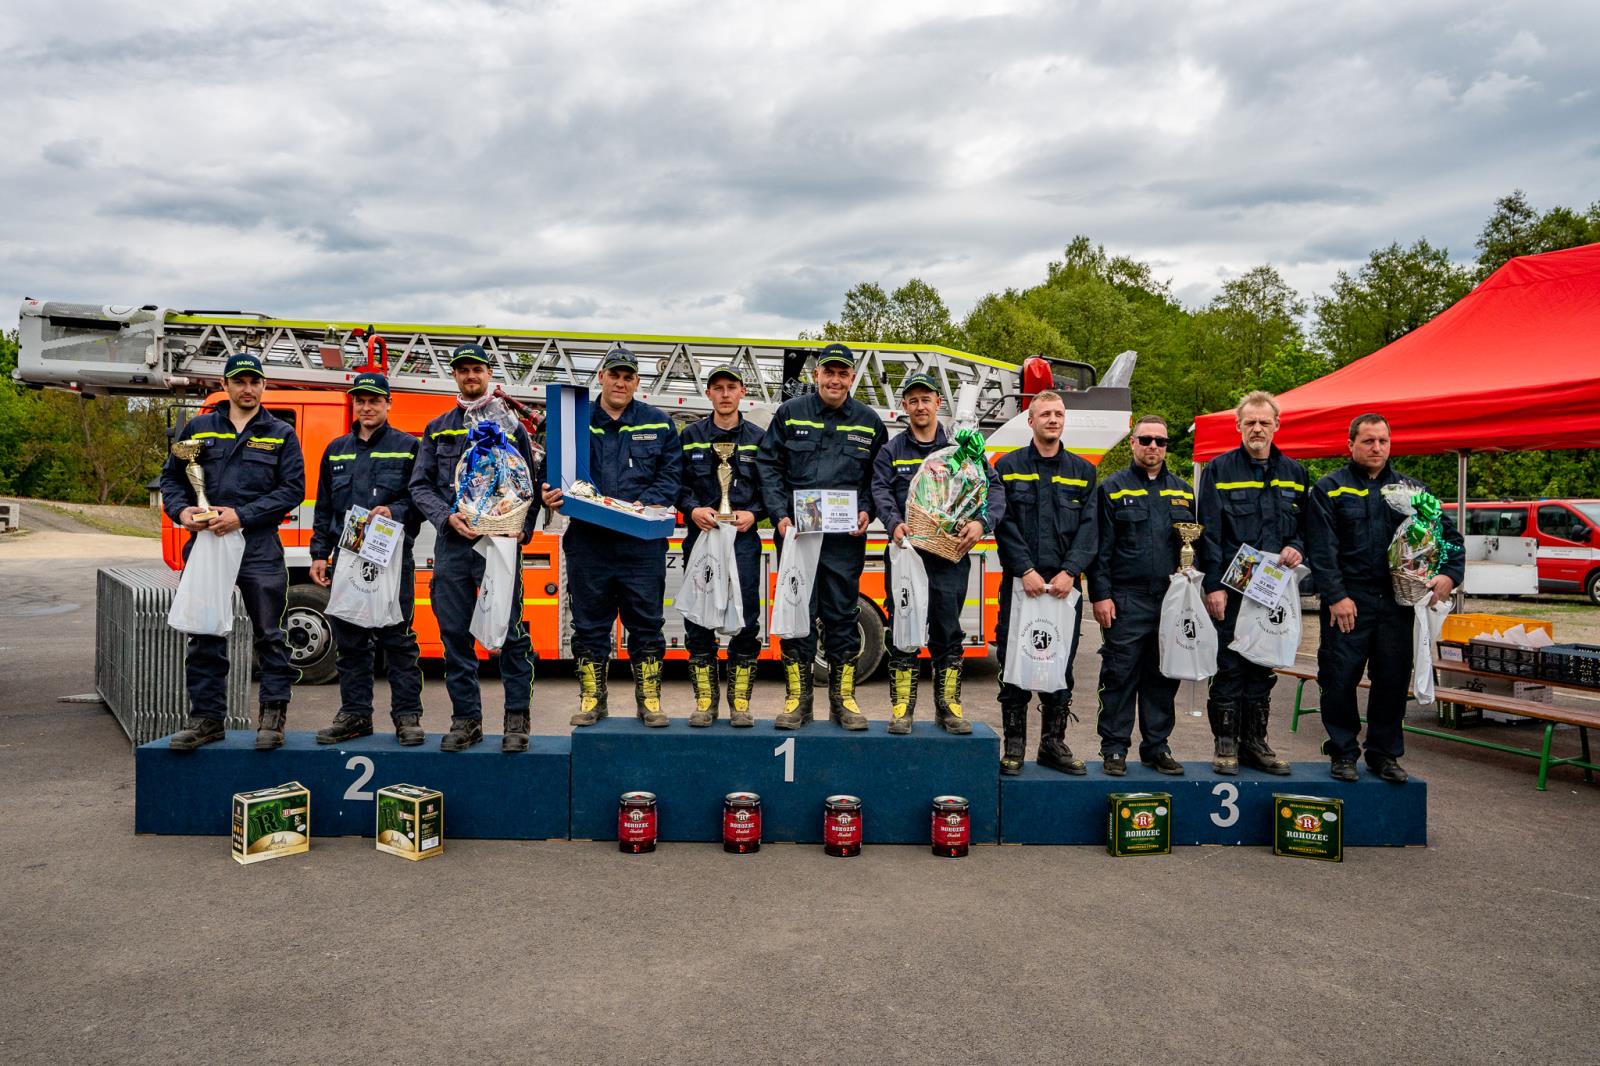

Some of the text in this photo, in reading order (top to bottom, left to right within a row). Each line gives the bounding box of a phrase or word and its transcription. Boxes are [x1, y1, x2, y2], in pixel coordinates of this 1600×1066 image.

[774, 737, 795, 782] 1
[343, 755, 375, 801] 2
[1210, 782, 1240, 828] 3
[1139, 816, 1148, 826] R
[1303, 818, 1313, 829] R
[1125, 829, 1161, 838] ROHOZEC
[1286, 830, 1329, 842] ROHOZEC
